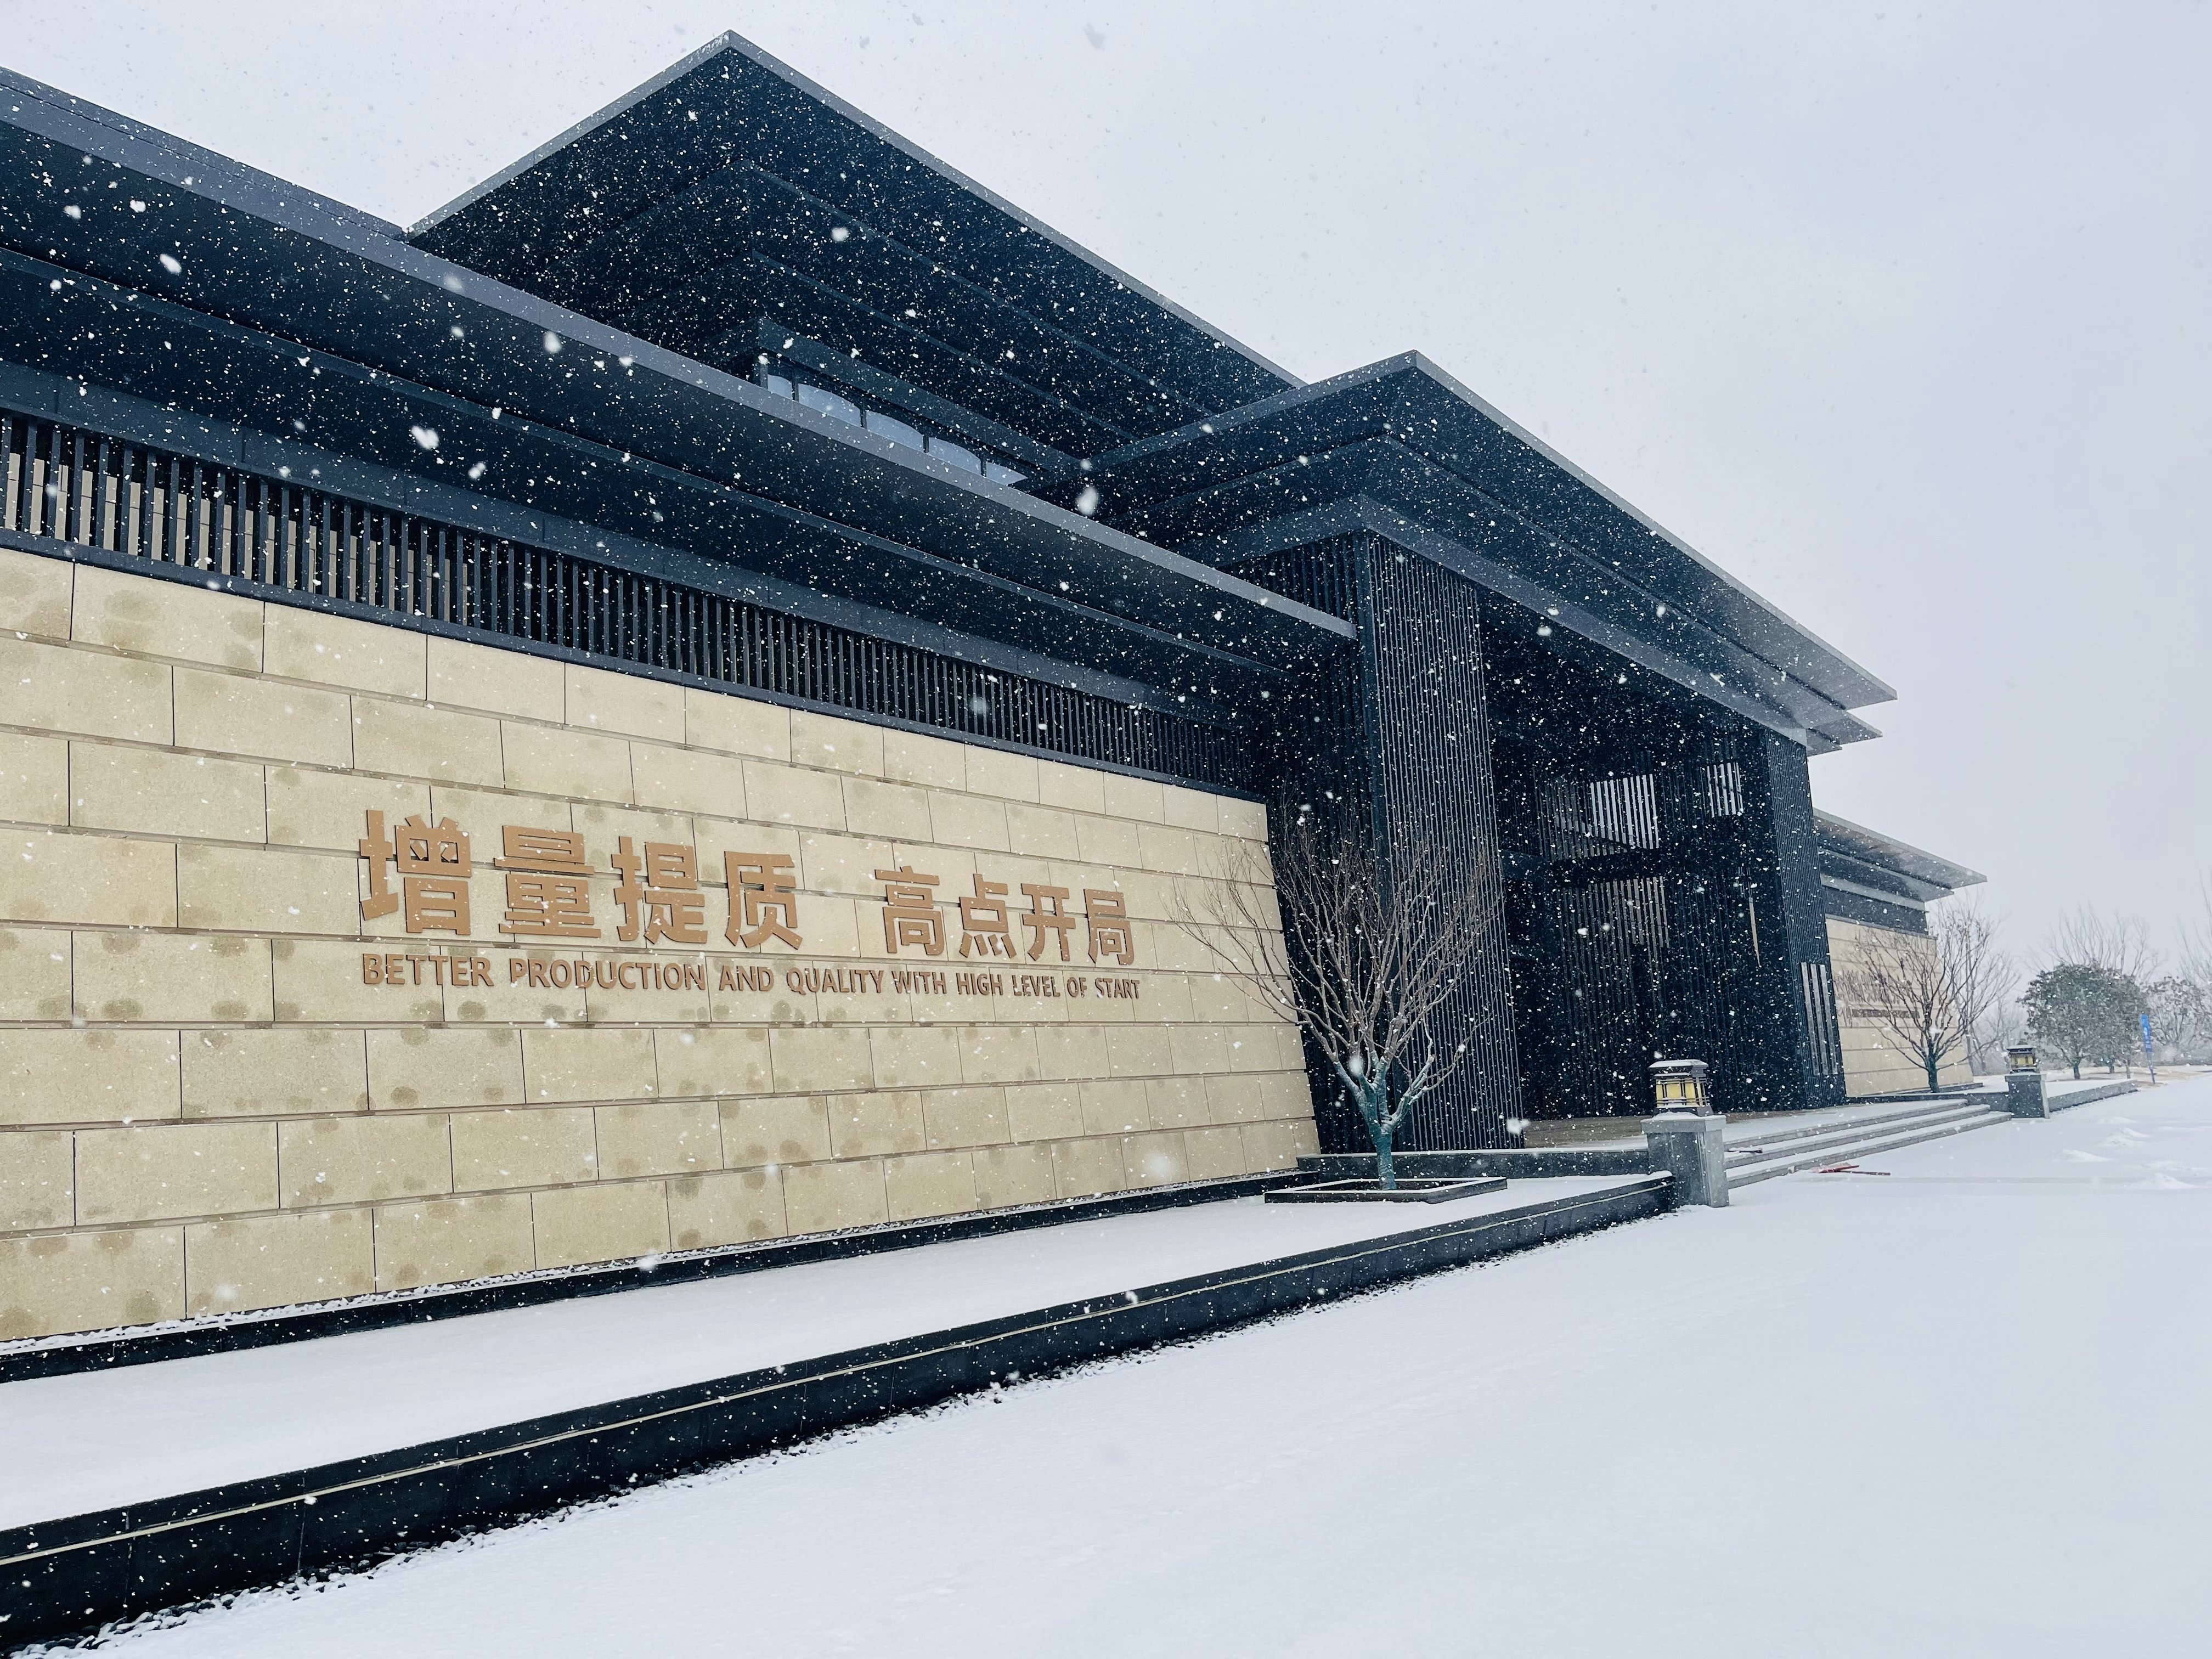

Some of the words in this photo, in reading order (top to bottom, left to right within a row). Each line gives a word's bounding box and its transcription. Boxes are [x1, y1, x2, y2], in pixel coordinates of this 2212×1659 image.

[359, 809, 803, 949] 增量提质
[875, 866, 1135, 966] 高点开局
[363, 953, 495, 986] BETTER
[510, 958, 706, 990] PRODUCTION
[718, 966, 775, 992] AND
[786, 968, 884, 996] QUALITY
[891, 970, 947, 995] WITH
[956, 973, 1003, 996] HIGH
[1012, 975, 1061, 998] LEVEL
[1067, 977, 1088, 998] OF
[1095, 978, 1141, 1000] START
